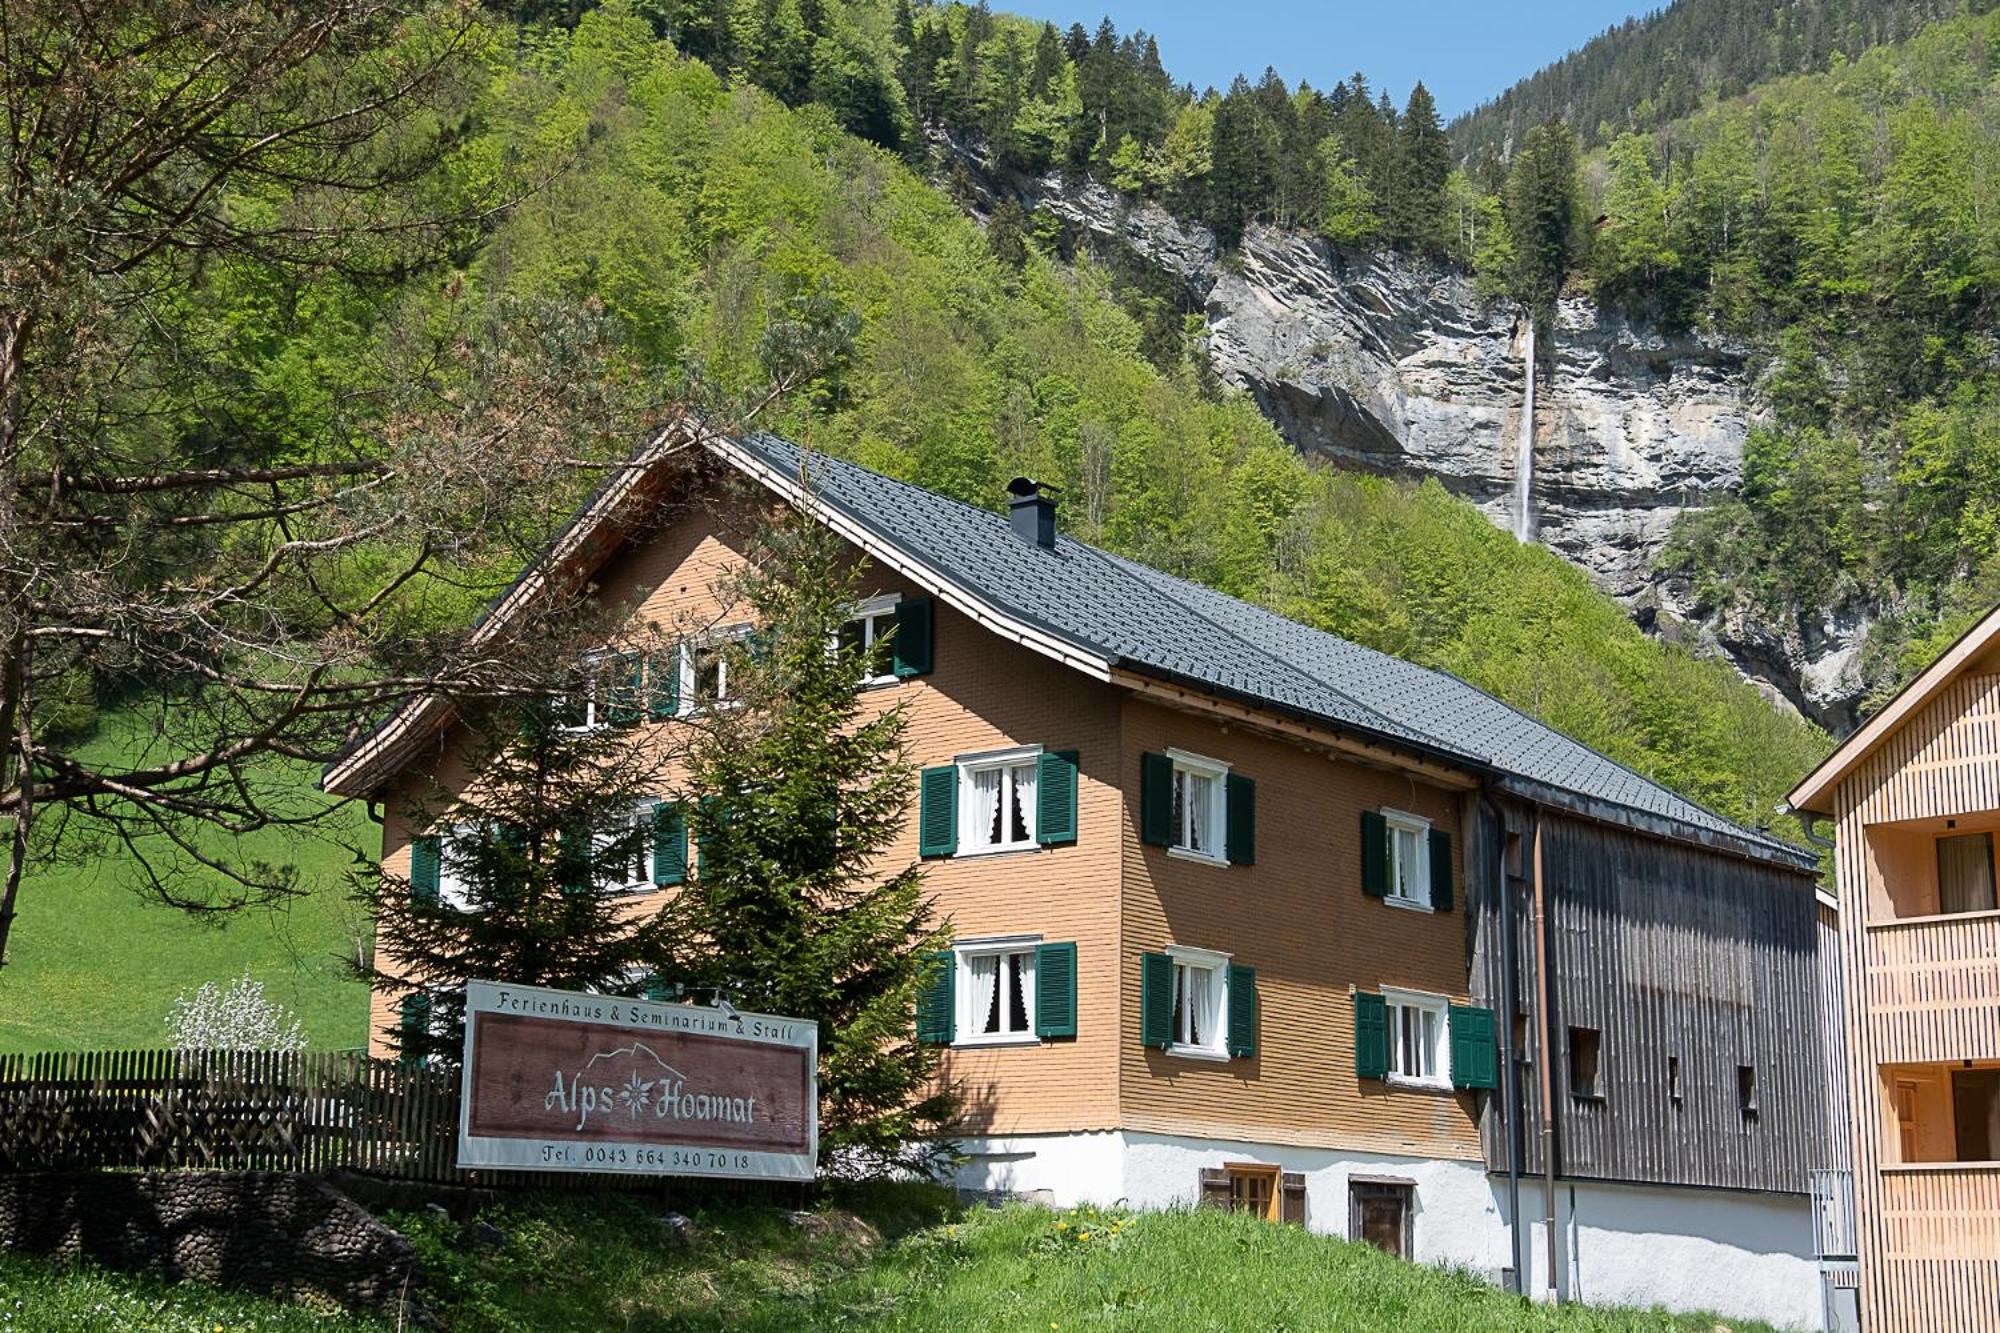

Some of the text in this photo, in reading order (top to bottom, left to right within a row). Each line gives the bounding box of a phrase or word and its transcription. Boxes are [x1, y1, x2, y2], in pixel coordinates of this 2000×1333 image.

[496, 991, 793, 1040] Ferienhaus & Seminarium & Stall
[544, 1070, 756, 1131] Alps Hoamat
[542, 1145, 750, 1169] Tel. 0043 664 340 70 18
